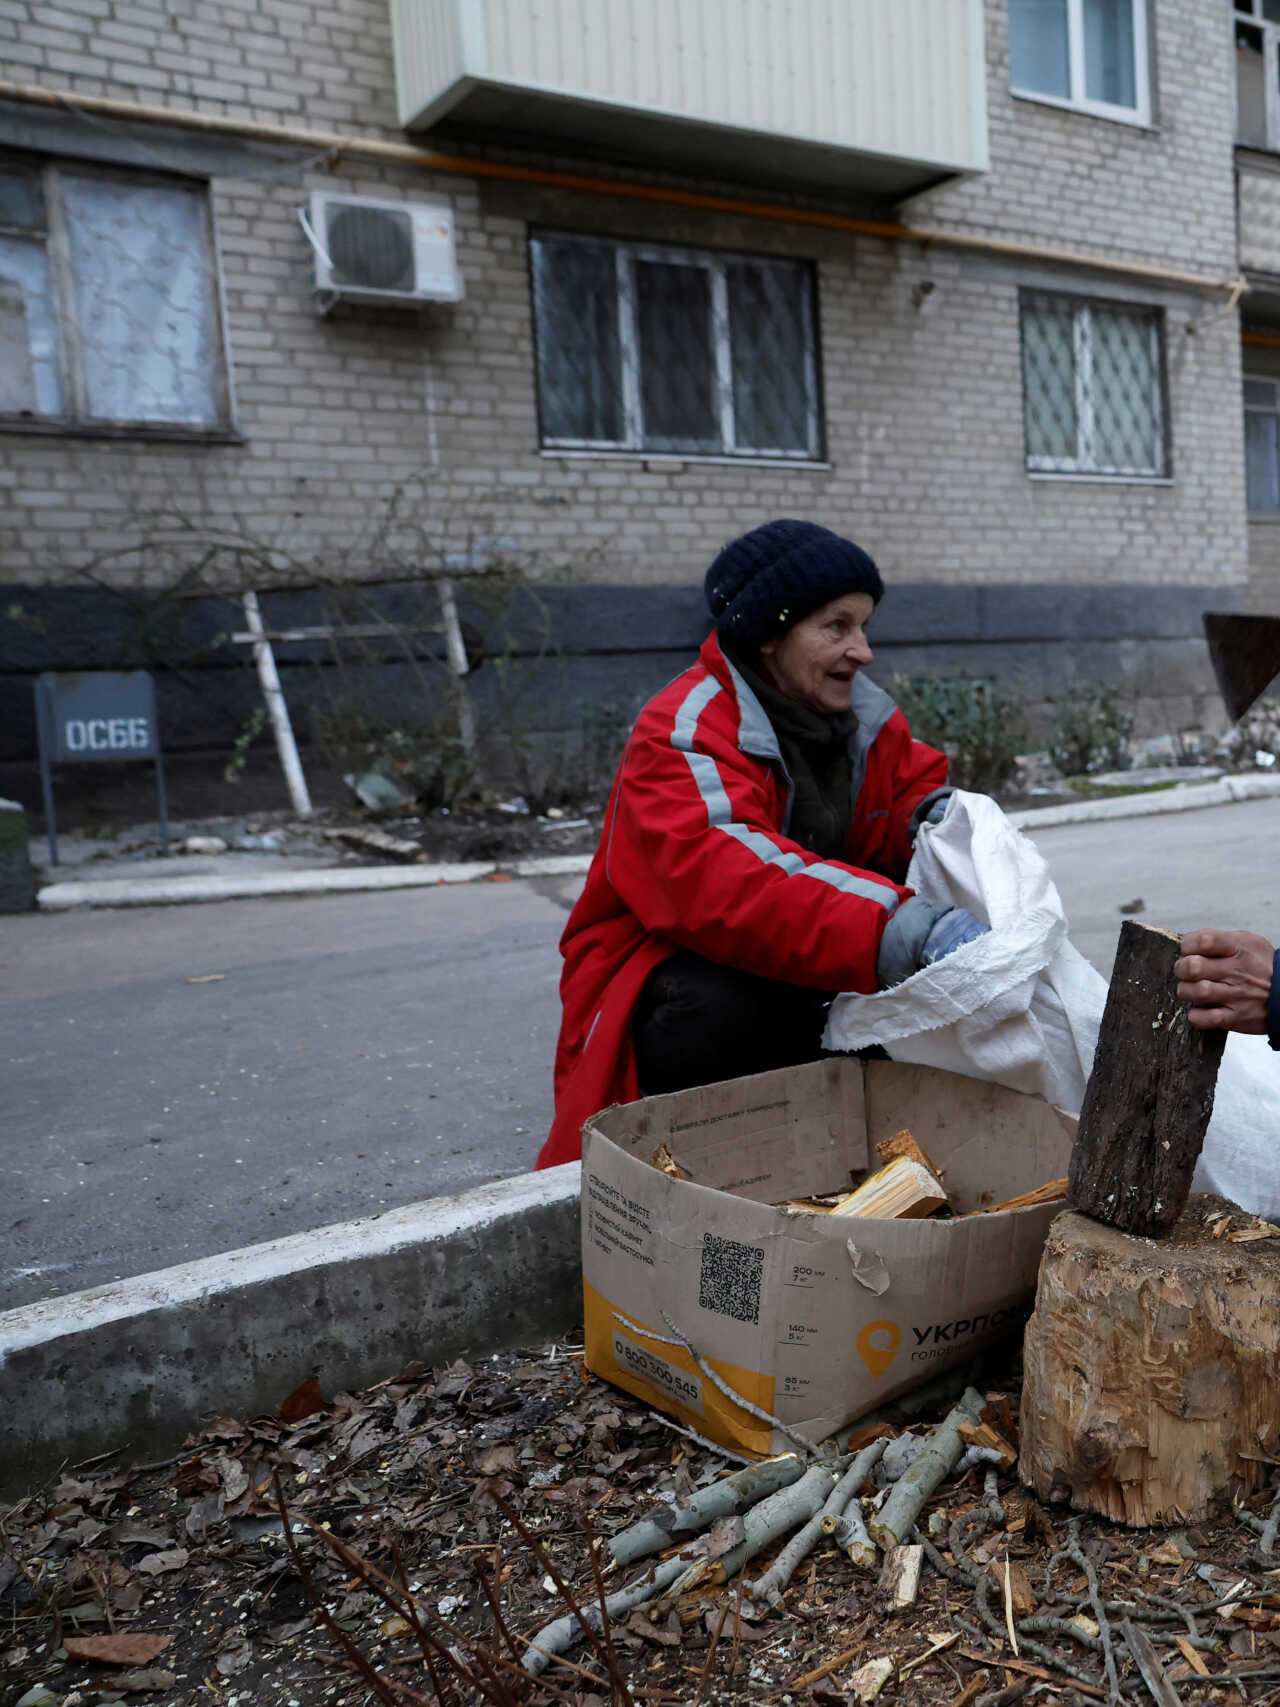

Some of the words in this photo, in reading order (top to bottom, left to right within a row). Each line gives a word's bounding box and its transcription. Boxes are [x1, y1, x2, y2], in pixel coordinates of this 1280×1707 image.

[66, 718, 148, 750] ОСББ
[793, 1266, 813, 1276] 200
[789, 1324, 805, 1333] 140
[616, 1341, 623, 1354] 0
[625, 1347, 648, 1369] 800
[649, 1361, 673, 1384] 300
[675, 1376, 698, 1400] 545
